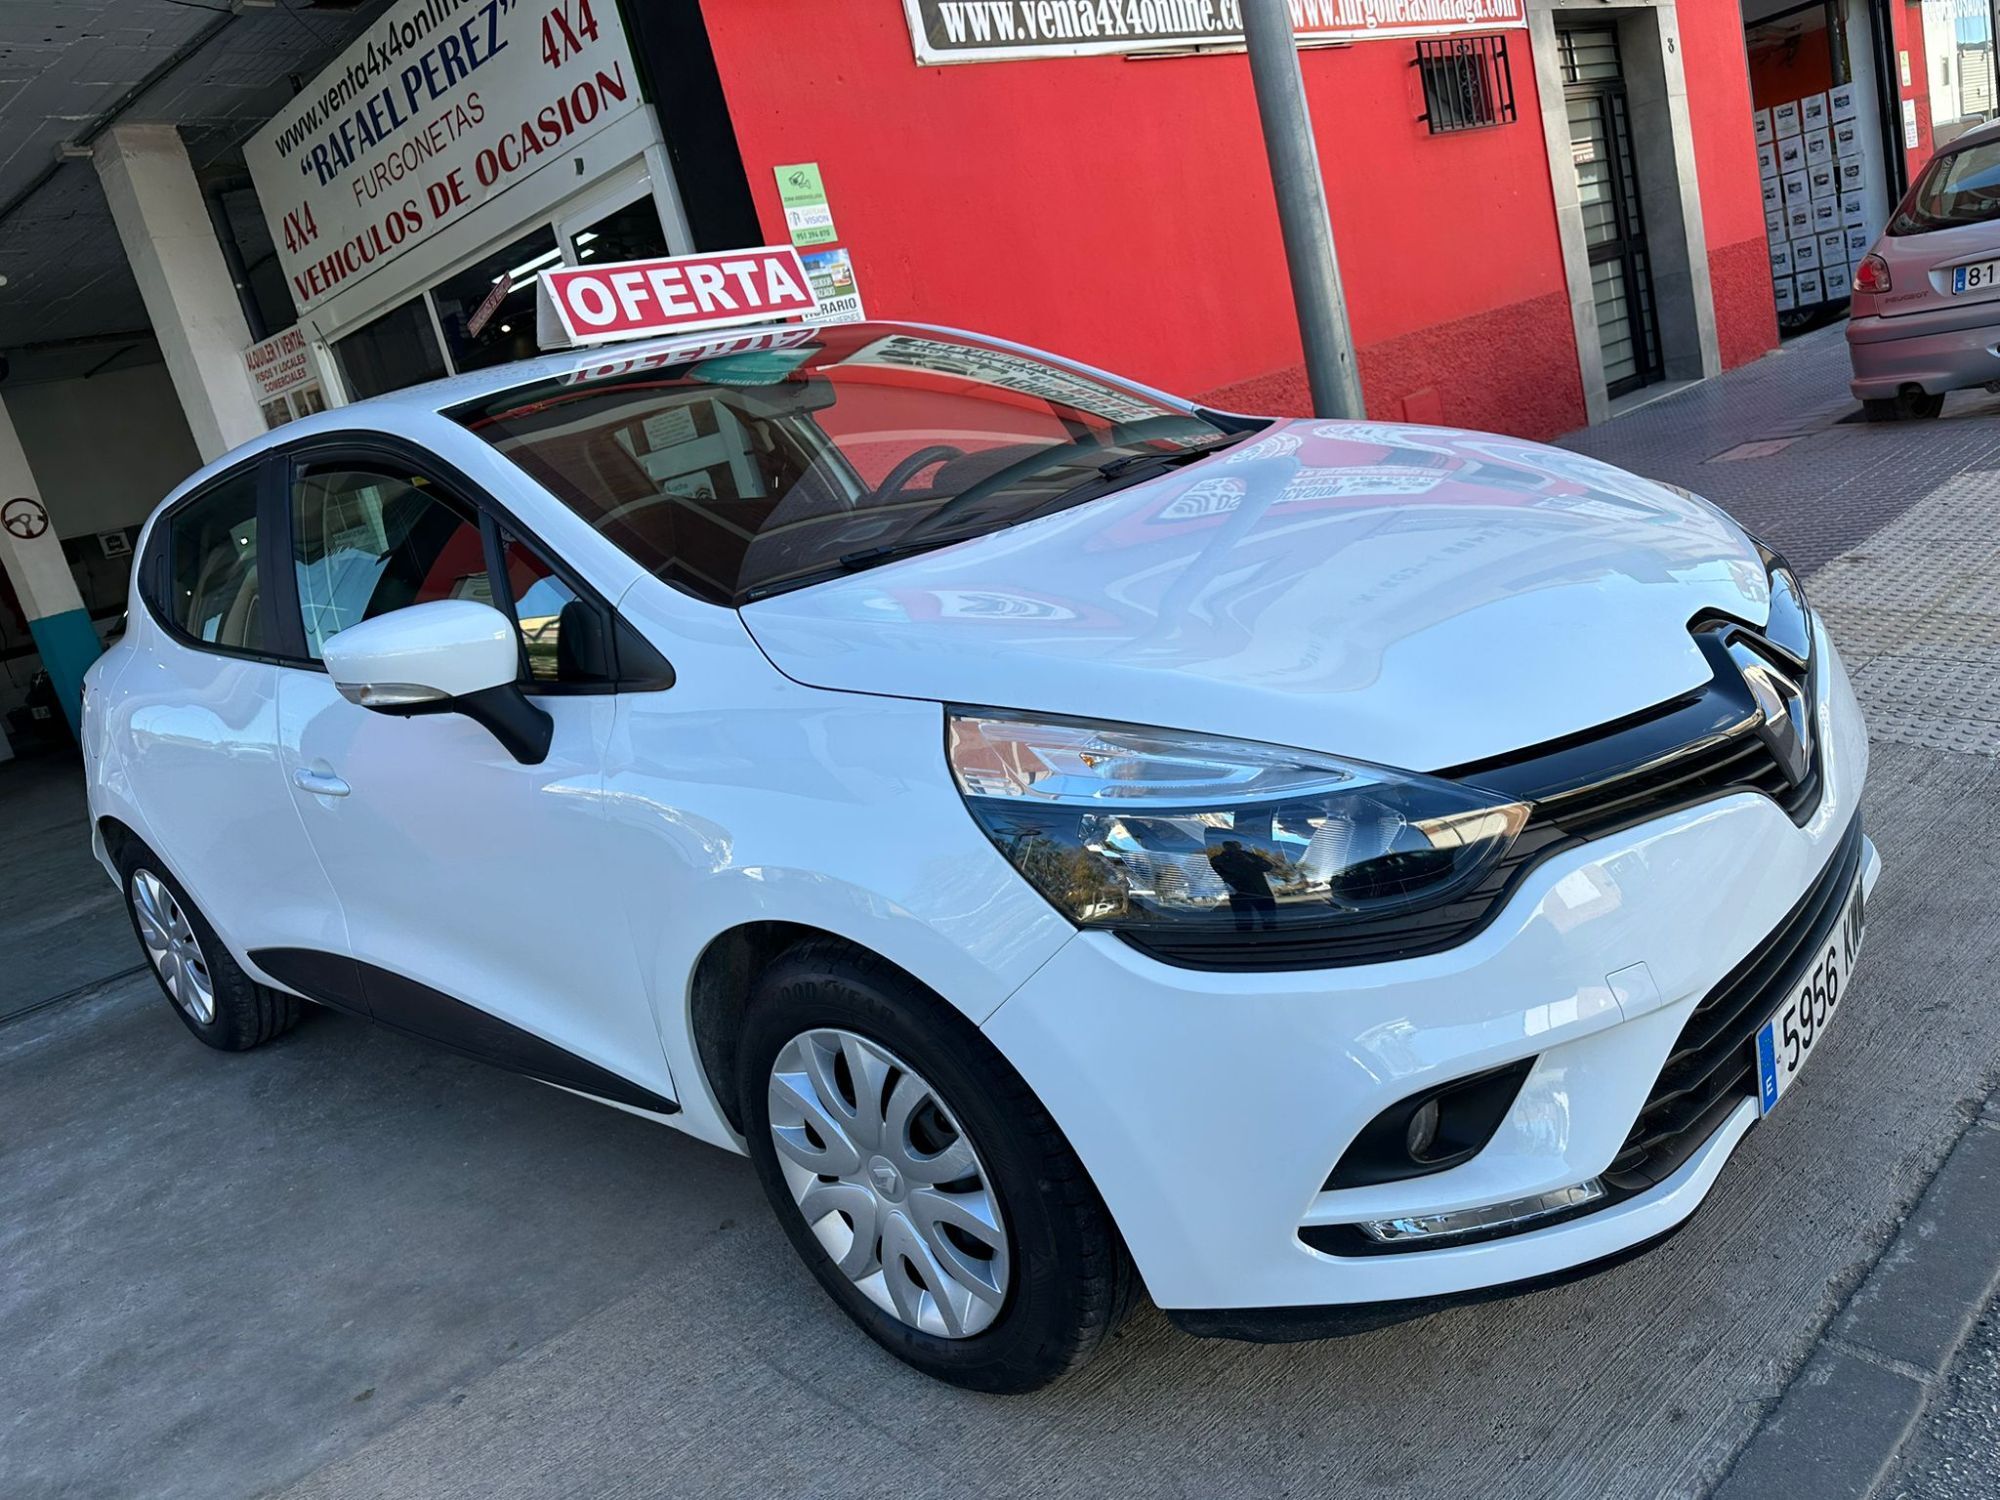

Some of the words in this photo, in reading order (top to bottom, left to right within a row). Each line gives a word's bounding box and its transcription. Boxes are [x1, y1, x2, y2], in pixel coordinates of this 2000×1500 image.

[275, 0, 469, 158] www.venta4x4onli
[542, 0, 599, 69] 4X4
[294, 199, 423, 301] VEHICULOS
[427, 167, 471, 219] DE
[475, 60, 627, 187] OCASION
[352, 92, 484, 208] FURGONETAS
[283, 200, 319, 255] 4X4
[565, 257, 807, 327] OFERTA
[1782, 945, 1838, 1073] 5956
[1765, 1074, 1774, 1097] E
